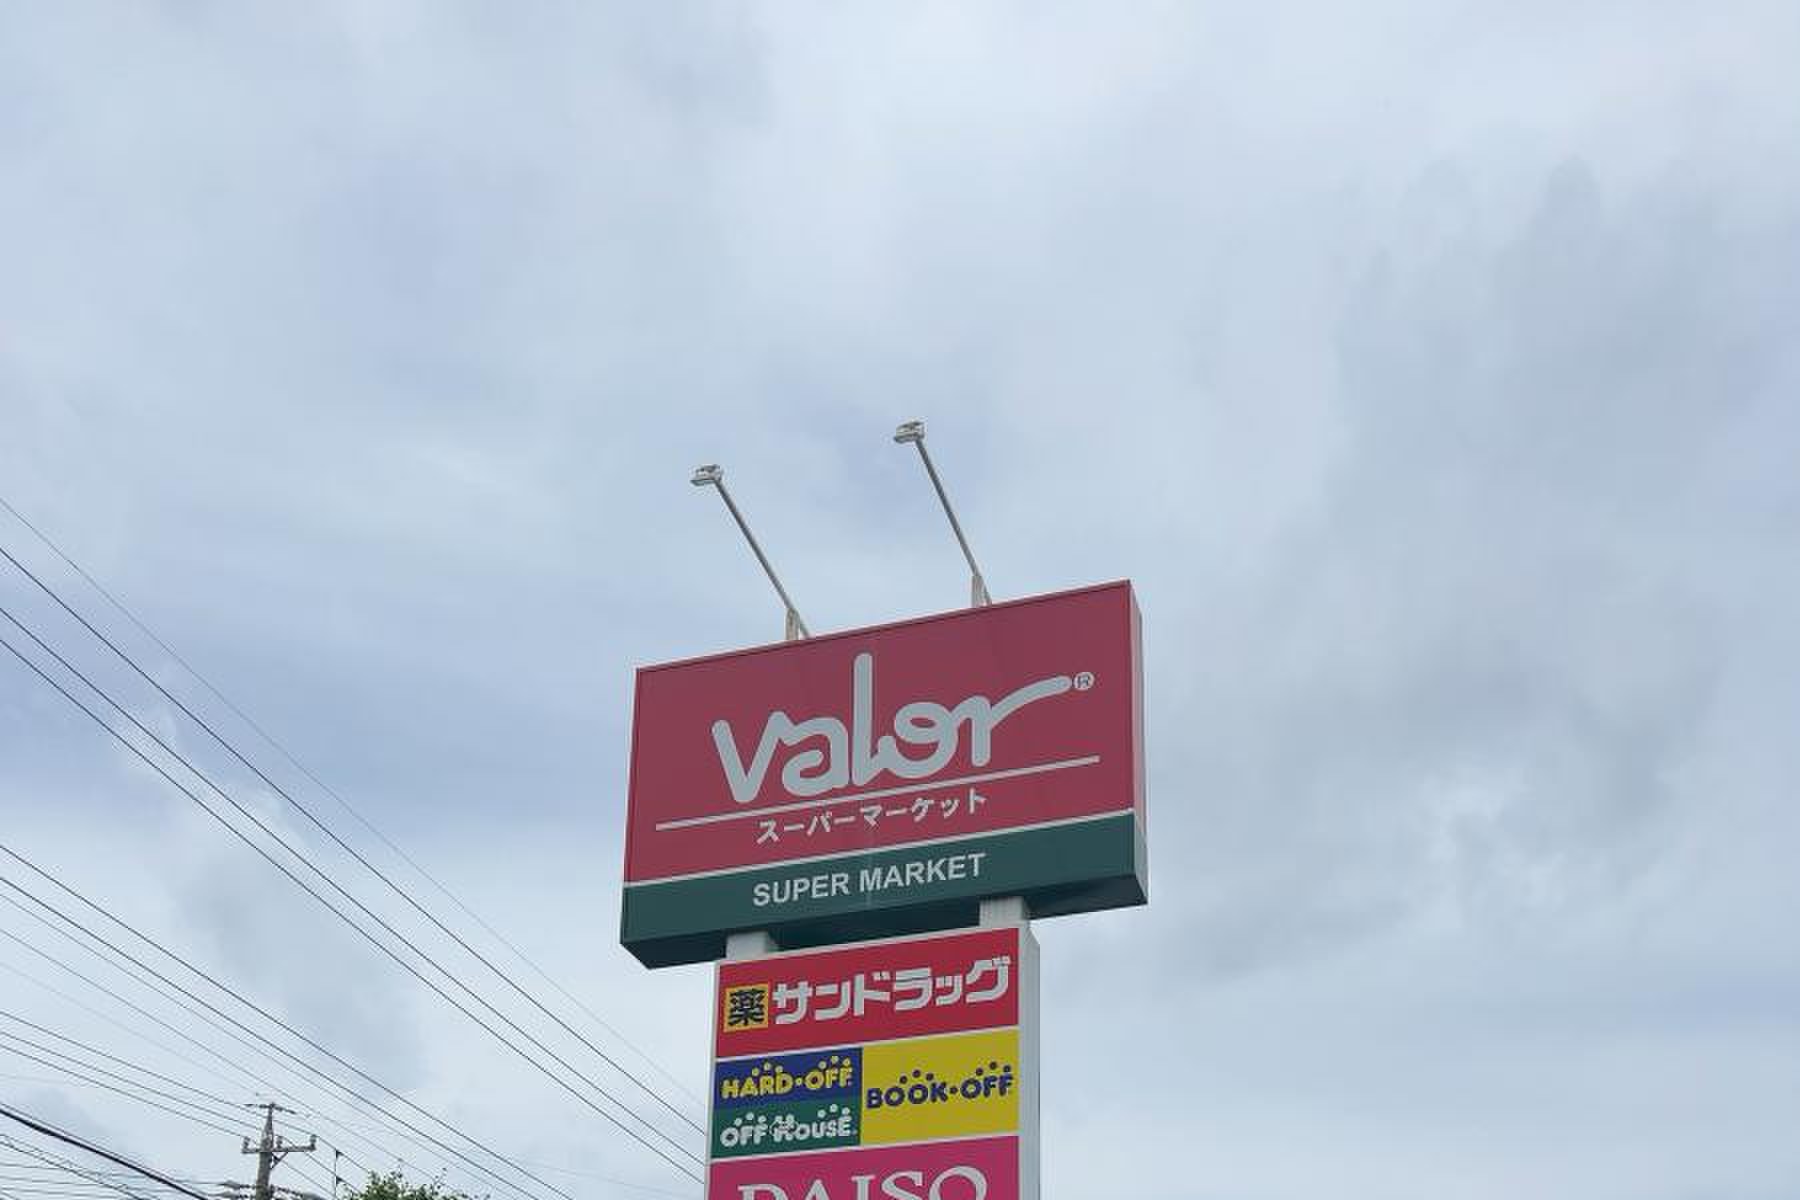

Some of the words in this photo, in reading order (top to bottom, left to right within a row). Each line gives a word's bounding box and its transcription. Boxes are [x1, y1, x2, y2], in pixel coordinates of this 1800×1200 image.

[755, 787, 987, 845] スーパーマーケット
[752, 872, 850, 906] SUPER
[859, 853, 987, 893] MARKET
[727, 987, 766, 1027] 薬
[772, 956, 1011, 1025] サンドラッグ
[720, 1122, 769, 1147] OFF
